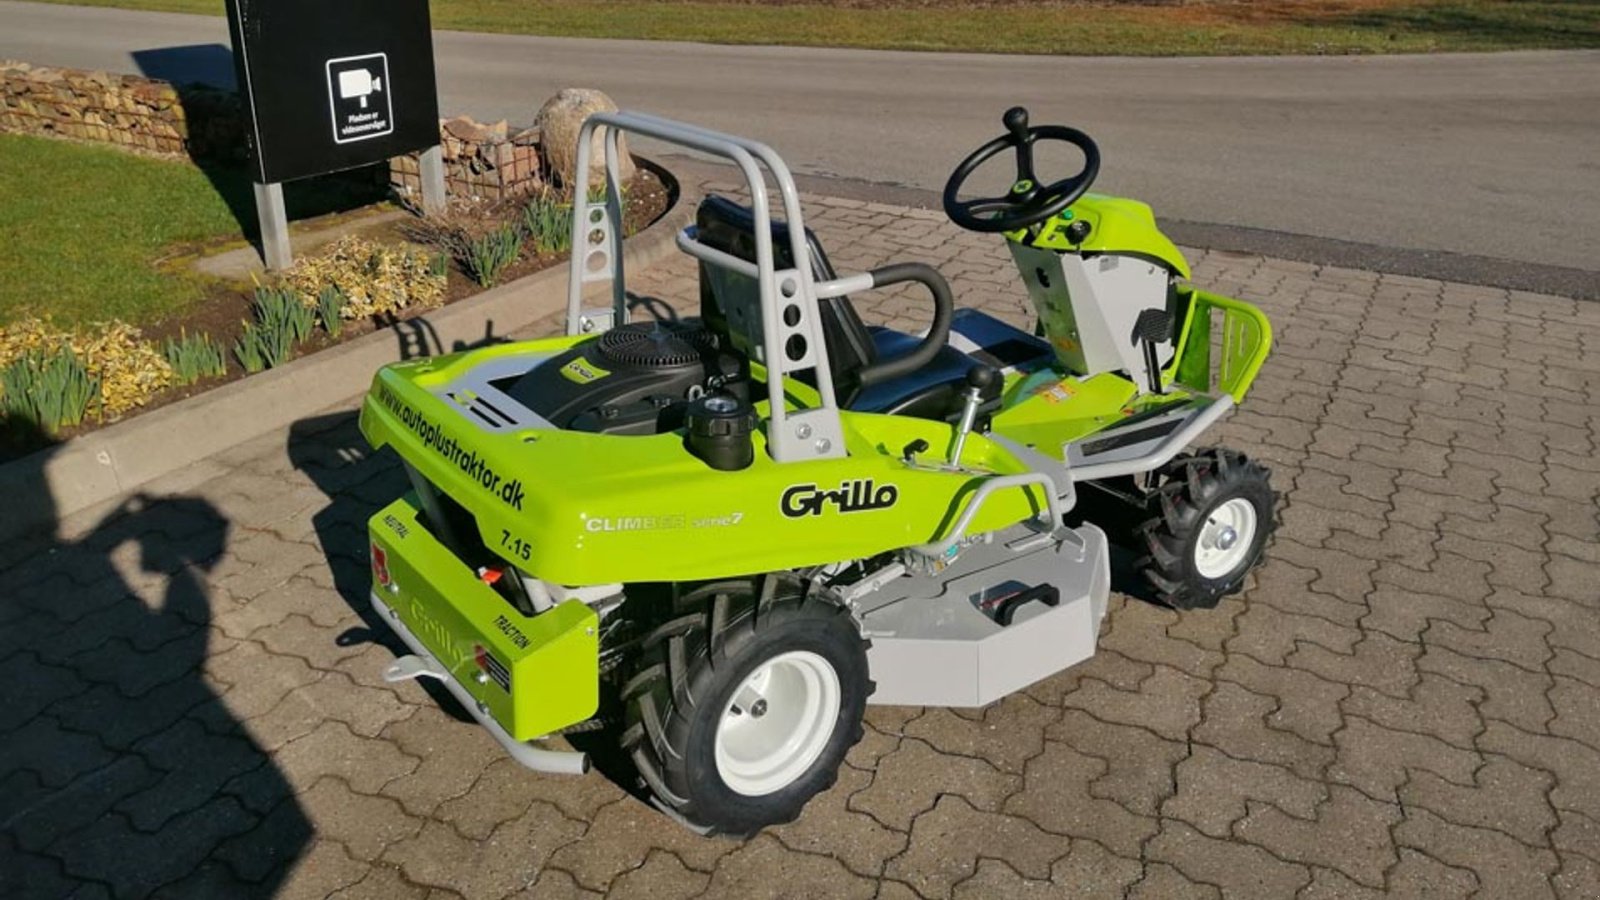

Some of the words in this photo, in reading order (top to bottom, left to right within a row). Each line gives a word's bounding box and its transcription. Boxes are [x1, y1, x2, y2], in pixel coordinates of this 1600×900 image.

[379, 384, 525, 512] www.autoplustraktor.dk
[780, 479, 898, 519] Grillo
[384, 513, 410, 539] NEUTRAL
[501, 529, 532, 561] 7.15
[493, 614, 531, 650] TRACTION
